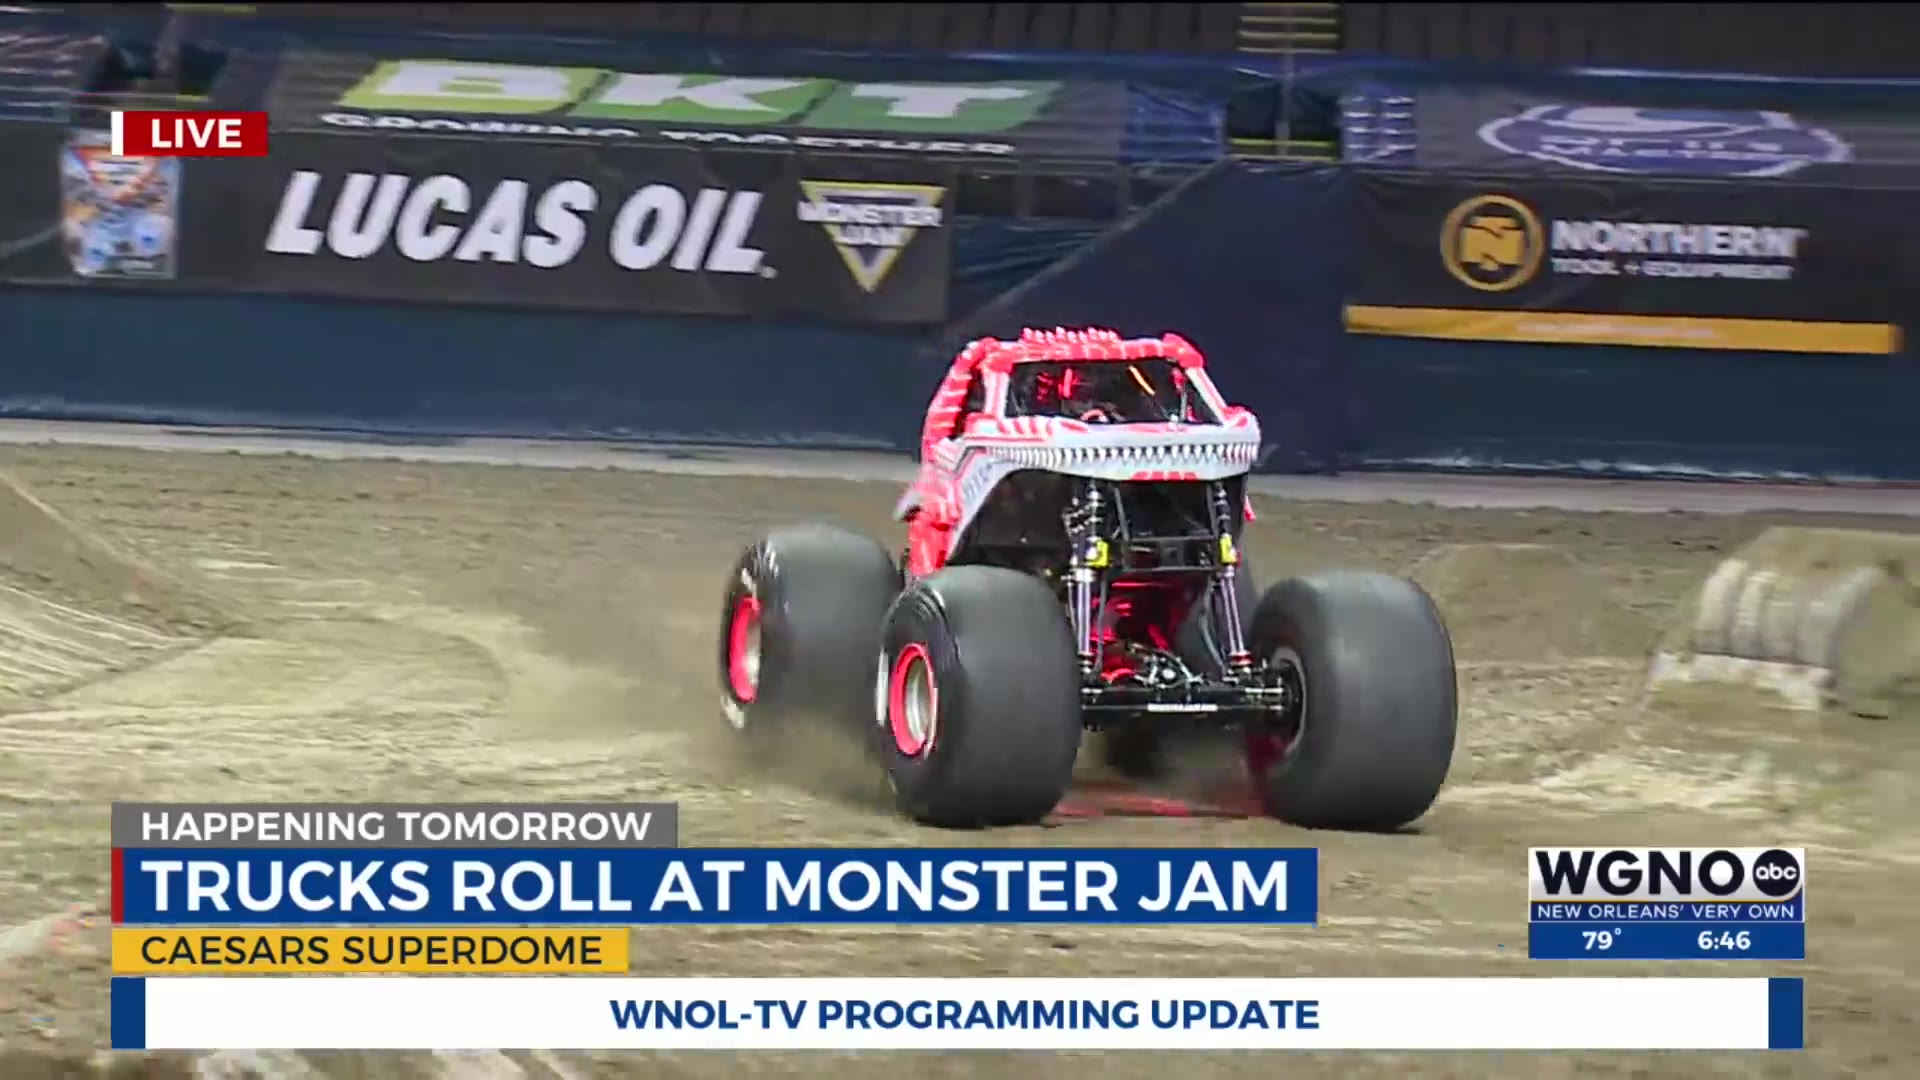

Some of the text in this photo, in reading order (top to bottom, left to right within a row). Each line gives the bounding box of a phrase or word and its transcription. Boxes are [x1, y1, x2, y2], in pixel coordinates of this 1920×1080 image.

[373, 60, 1031, 119] BKT
[266, 171, 597, 269] LUCAS
[797, 200, 945, 228] MONSTER
[833, 222, 909, 247] JAM
[1550, 219, 1800, 259] NORTHERN
[1550, 256, 1620, 276] TOOL
[1642, 260, 1795, 280] EQUIPMENT
